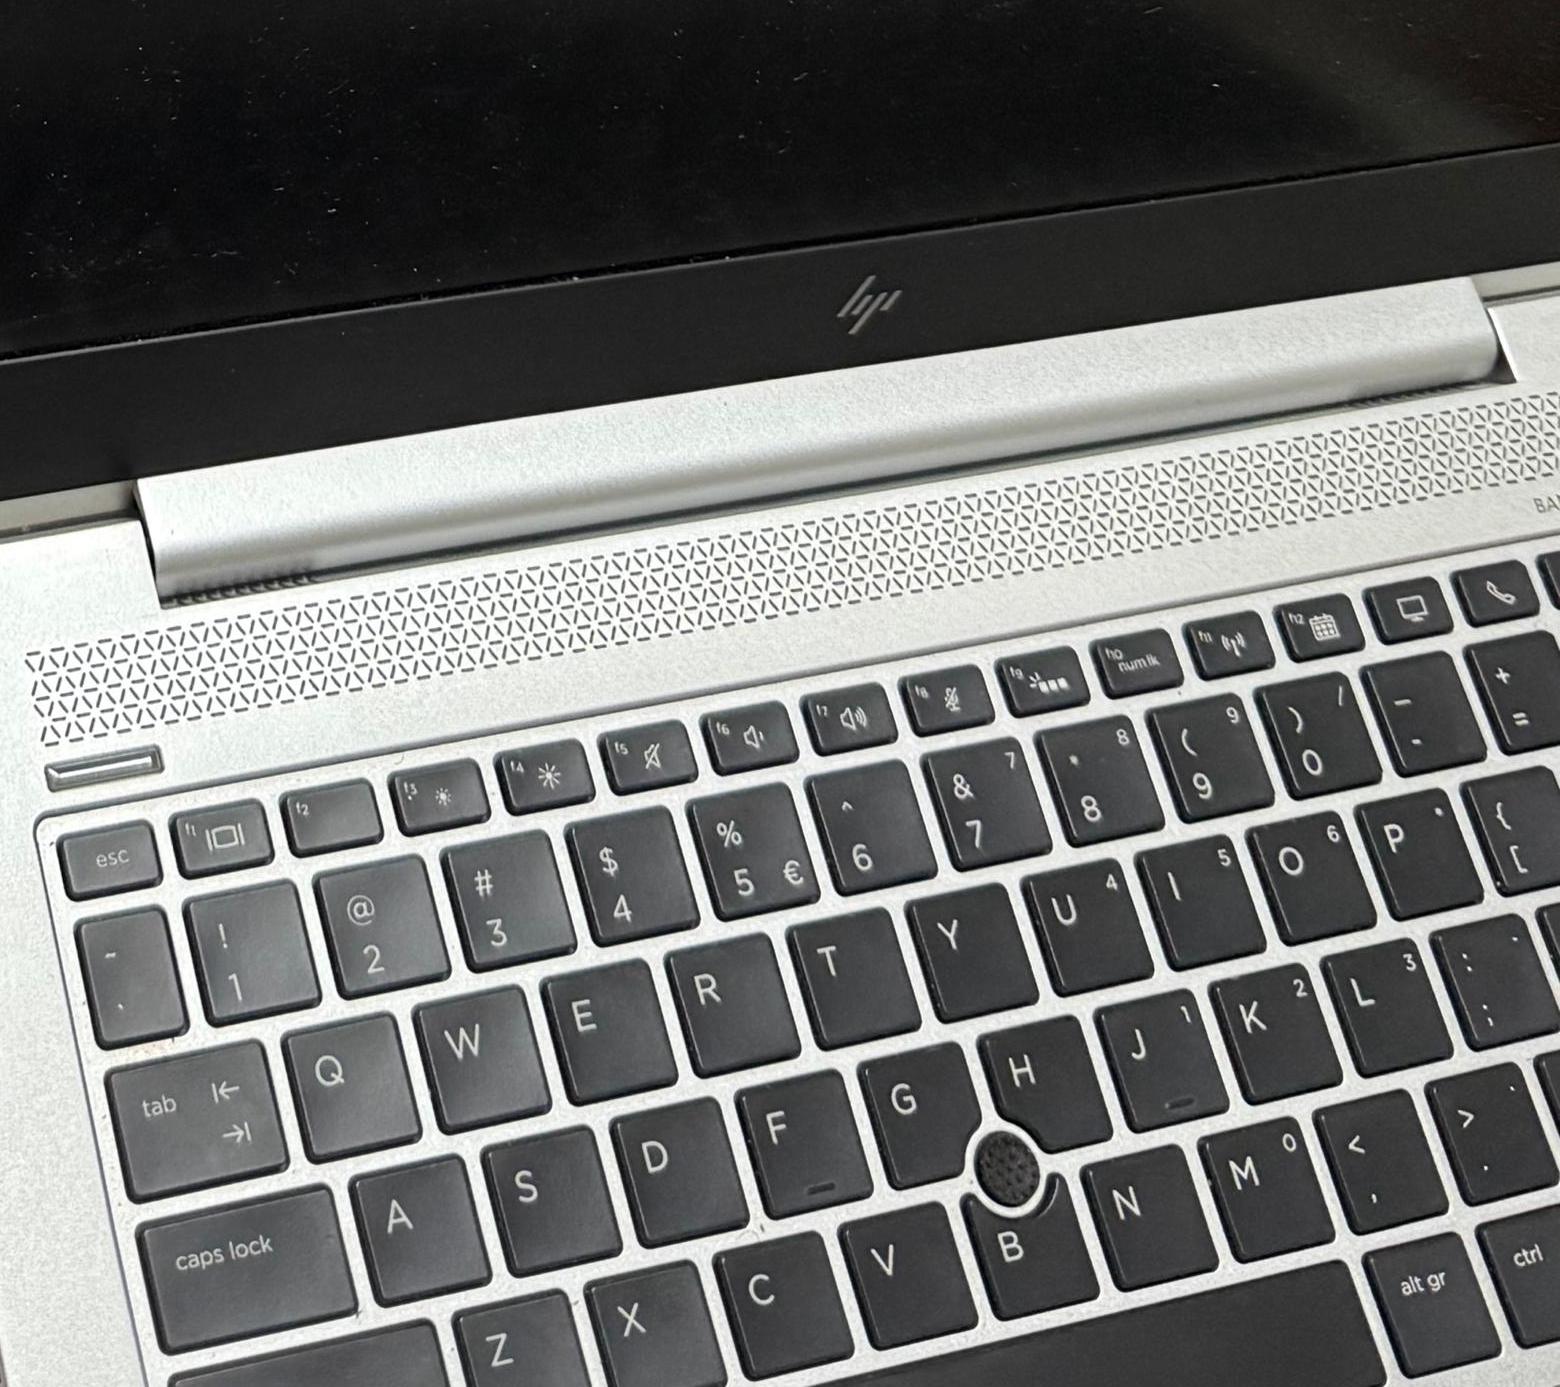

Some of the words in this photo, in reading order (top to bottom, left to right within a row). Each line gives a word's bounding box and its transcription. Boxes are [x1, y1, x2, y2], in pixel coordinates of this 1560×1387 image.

[836, 274, 903, 335] hp
[1118, 657, 1147, 672] num
[1225, 706, 1240, 724] 9
[1116, 728, 1131, 746] 8
[1004, 751, 1015, 770] 7
[952, 773, 974, 800] &
[1192, 772, 1213, 800] 9
[295, 802, 310, 816] f2
[1080, 795, 1102, 823] 8
[716, 820, 743, 848] %
[965, 819, 982, 849] 7
[1326, 824, 1341, 843] 6
[1383, 823, 1405, 853] P
[95, 849, 130, 868] esc
[599, 846, 619, 877] $
[782, 859, 804, 886] €
[852, 843, 873, 872] 6
[1217, 848, 1232, 867] 5
[1278, 846, 1304, 876] O
[474, 869, 494, 897] #
[733, 868, 755, 897] 5
[1105, 873, 1118, 891] 4
[346, 894, 375, 926] @
[613, 894, 633, 923] 4
[1051, 894, 1077, 926] U
[486, 918, 508, 948] 3
[937, 919, 958, 950] Y
[363, 944, 385, 975] 2
[816, 945, 837, 977] T
[1402, 953, 1417, 972] 3
[228, 973, 243, 1002] 1
[693, 973, 722, 1006] R
[1292, 978, 1308, 998] 2
[1350, 978, 1376, 1007] L
[571, 999, 597, 1033] E
[1238, 1000, 1267, 1034] K
[443, 1023, 480, 1060] W
[1131, 1028, 1147, 1060] J
[314, 1055, 345, 1087] Q
[1008, 1054, 1036, 1088] H
[142, 1094, 177, 1118] tab
[890, 1083, 917, 1115] G
[766, 1110, 787, 1145] F
[641, 1140, 669, 1174] D
[514, 1170, 538, 1203] S
[1228, 1155, 1260, 1191] M
[387, 1199, 414, 1234] A
[1112, 1185, 1141, 1220] N
[175, 1248, 225, 1271] caps
[228, 1234, 274, 1260] lock
[870, 1244, 894, 1276] V
[997, 1230, 1025, 1263] B
[1513, 1243, 1544, 1267] ctrl
[748, 1273, 775, 1306] C
[1400, 1275, 1425, 1296] alt
[1426, 1271, 1446, 1292] gr
[617, 1302, 647, 1338] X
[485, 1332, 514, 1367] Z
